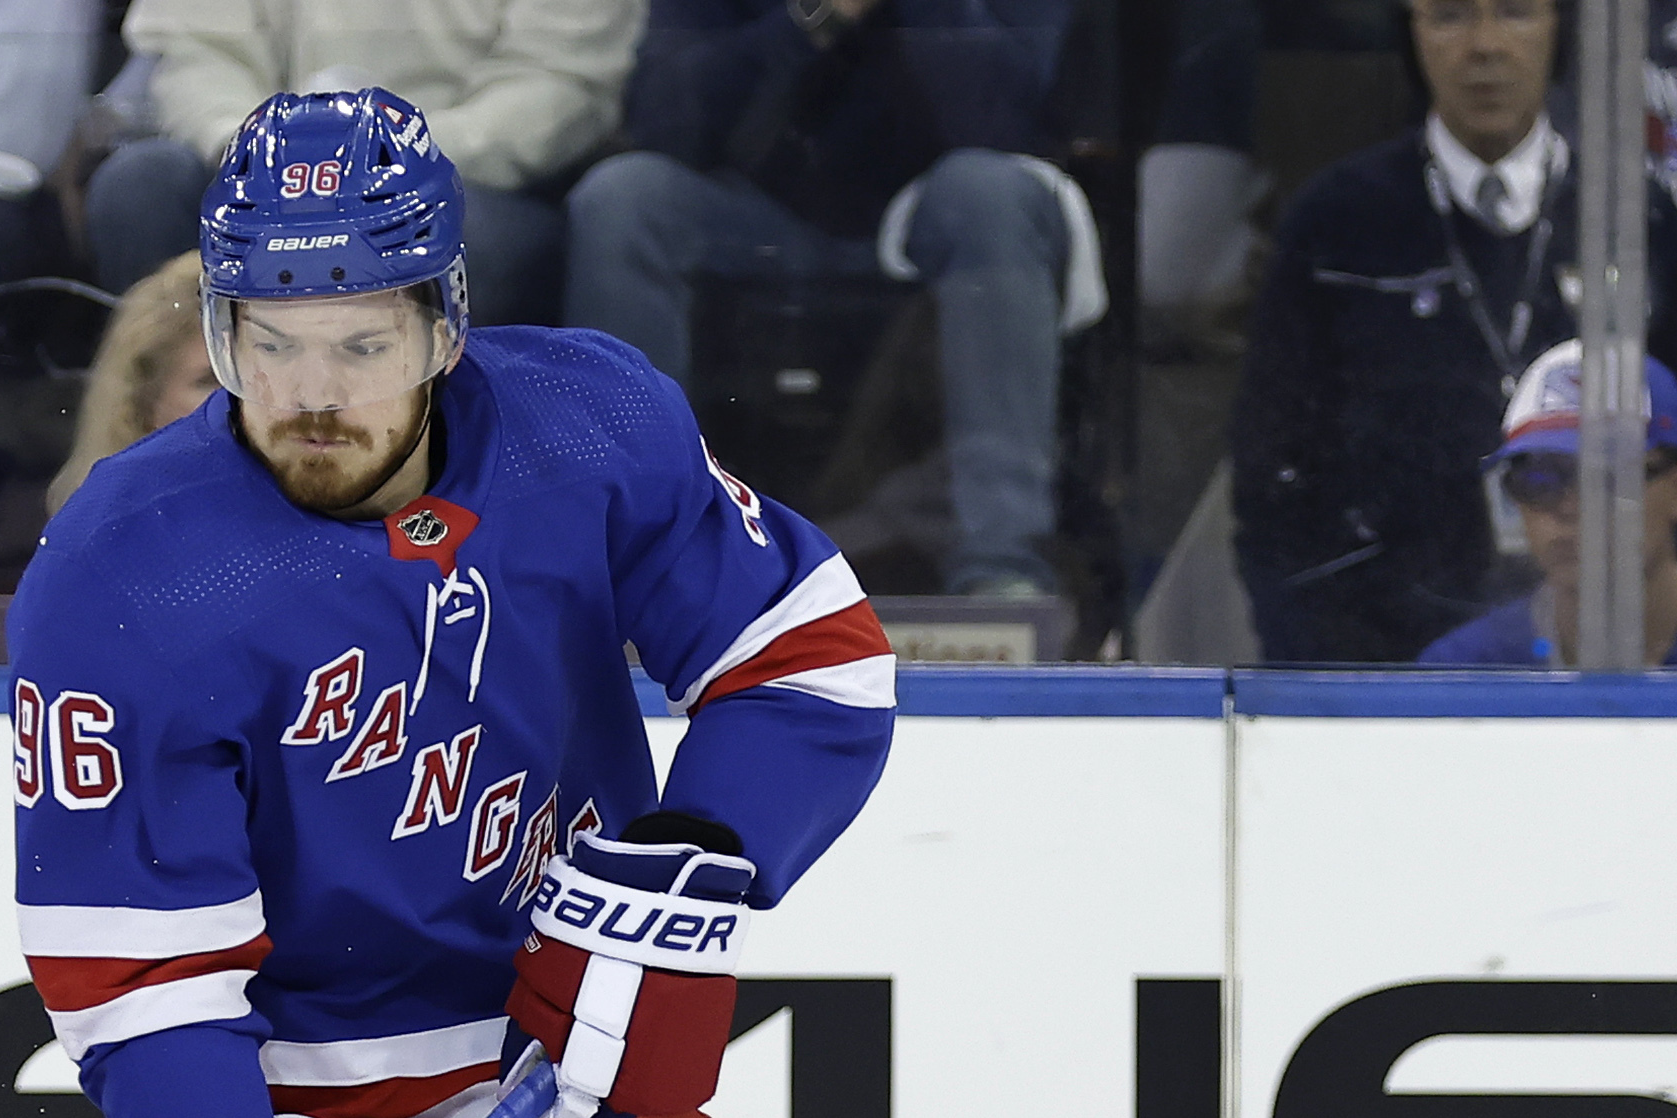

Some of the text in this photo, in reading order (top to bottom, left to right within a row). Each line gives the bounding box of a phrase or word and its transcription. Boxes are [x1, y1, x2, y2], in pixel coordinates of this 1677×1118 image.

[280, 160, 342, 199] 96
[266, 233, 350, 252] BAUER
[15, 677, 123, 811] 96
